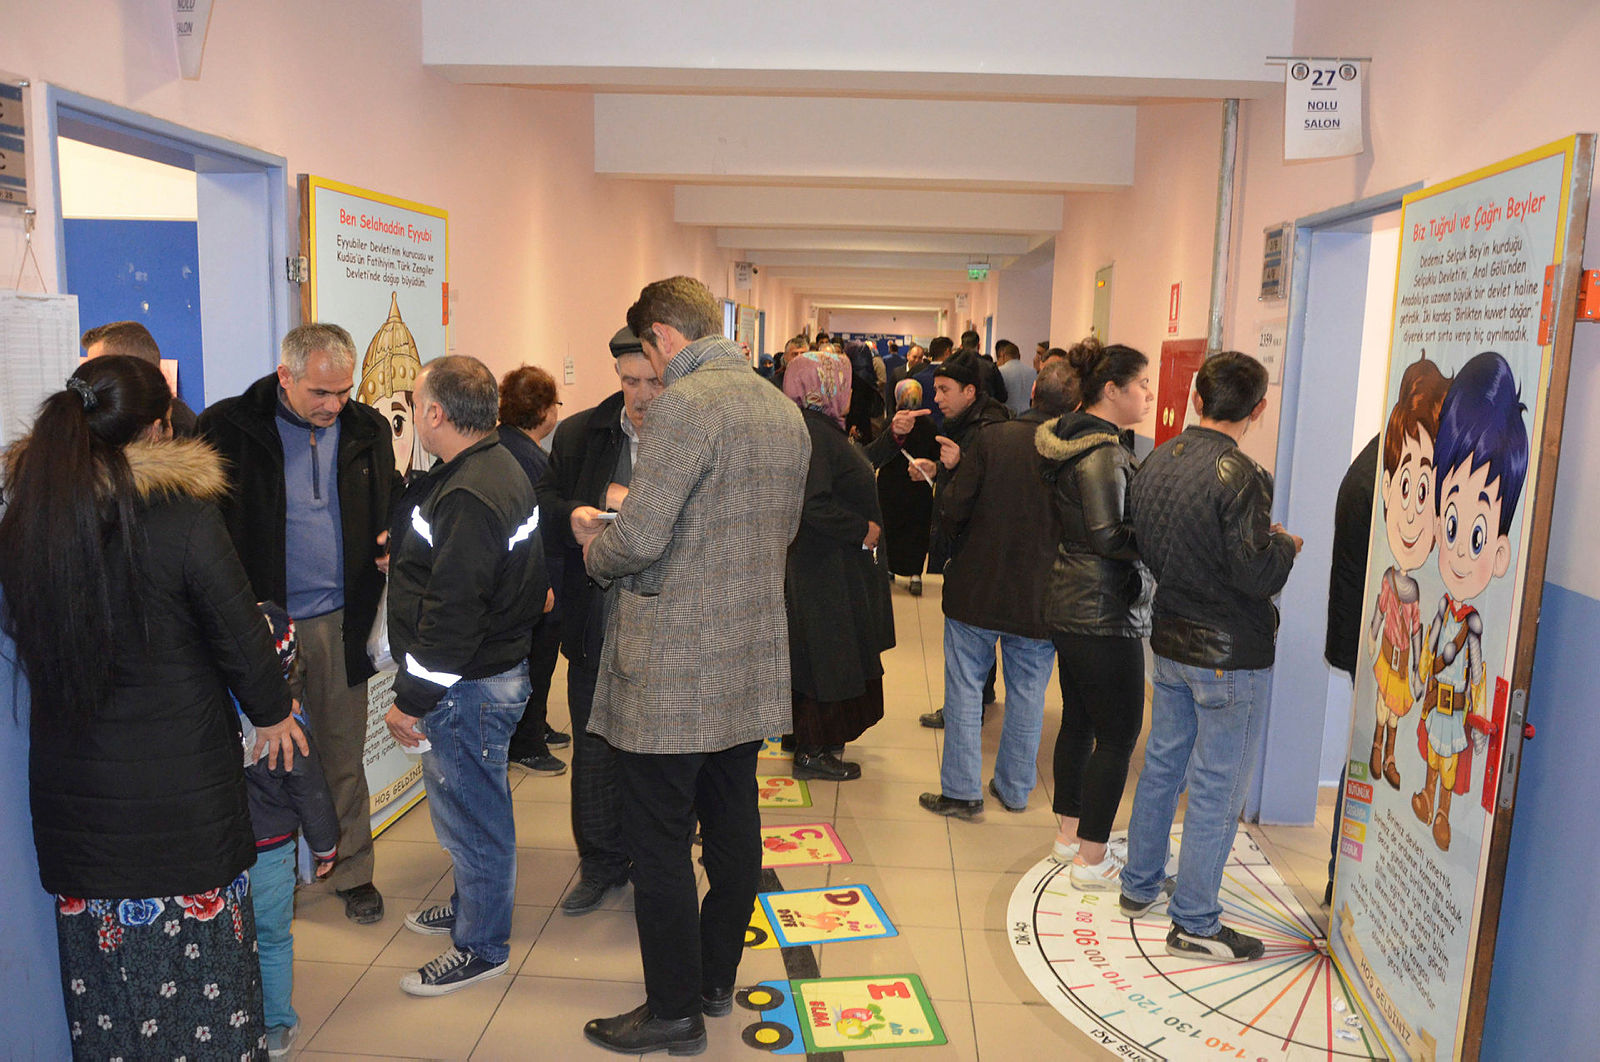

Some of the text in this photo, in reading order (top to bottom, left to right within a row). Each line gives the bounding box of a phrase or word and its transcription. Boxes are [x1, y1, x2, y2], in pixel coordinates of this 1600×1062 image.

[1312, 69, 1336, 86] 27
[1308, 101, 1338, 110] NOLU
[1304, 119, 1341, 129] SALON
[1413, 191, 1546, 242] Biz Tuğrul ve Çağrı Beyler
[339, 208, 433, 245] Ben Selahaddin Eyyubi
[336, 234, 368, 250] Eyyubiler
[402, 247, 427, 261] kurucusu
[428, 254, 434, 262] ve
[1420, 252, 1444, 269] Dedemiz
[1446, 246, 1467, 264] Selçuk
[1492, 235, 1523, 257] kurduğu
[397, 260, 410, 272] Türk
[1472, 262, 1488, 279] Aral
[382, 273, 400, 286] doğup
[1453, 287, 1472, 304] büyük
[1475, 287, 1485, 299] bir
[1487, 283, 1511, 299] devlet
[1513, 279, 1539, 297] haline
[1484, 304, 1507, 320] kuvvet
[1455, 327, 1471, 344] verip
[1474, 326, 1484, 344] hiç
[375, 763, 424, 807] HOŞ GELDİNİ
[766, 778, 795, 787] C
[790, 828, 823, 840] Ç
[824, 891, 860, 906] D
[1080, 894, 1100, 906] 70
[1075, 911, 1093, 924] 80
[1073, 928, 1100, 946] 90
[1084, 949, 1110, 969] 100
[1102, 971, 1132, 992] 110
[867, 982, 911, 1000] E
[1128, 993, 1163, 1015] 120
[1360, 957, 1412, 1046] HOŞ GELDİNİZ
[809, 1000, 831, 1028] ELMA
[1164, 1016, 1202, 1038] 130
[1090, 1029, 1117, 1045] Açı
[1205, 1037, 1247, 1059] 140
